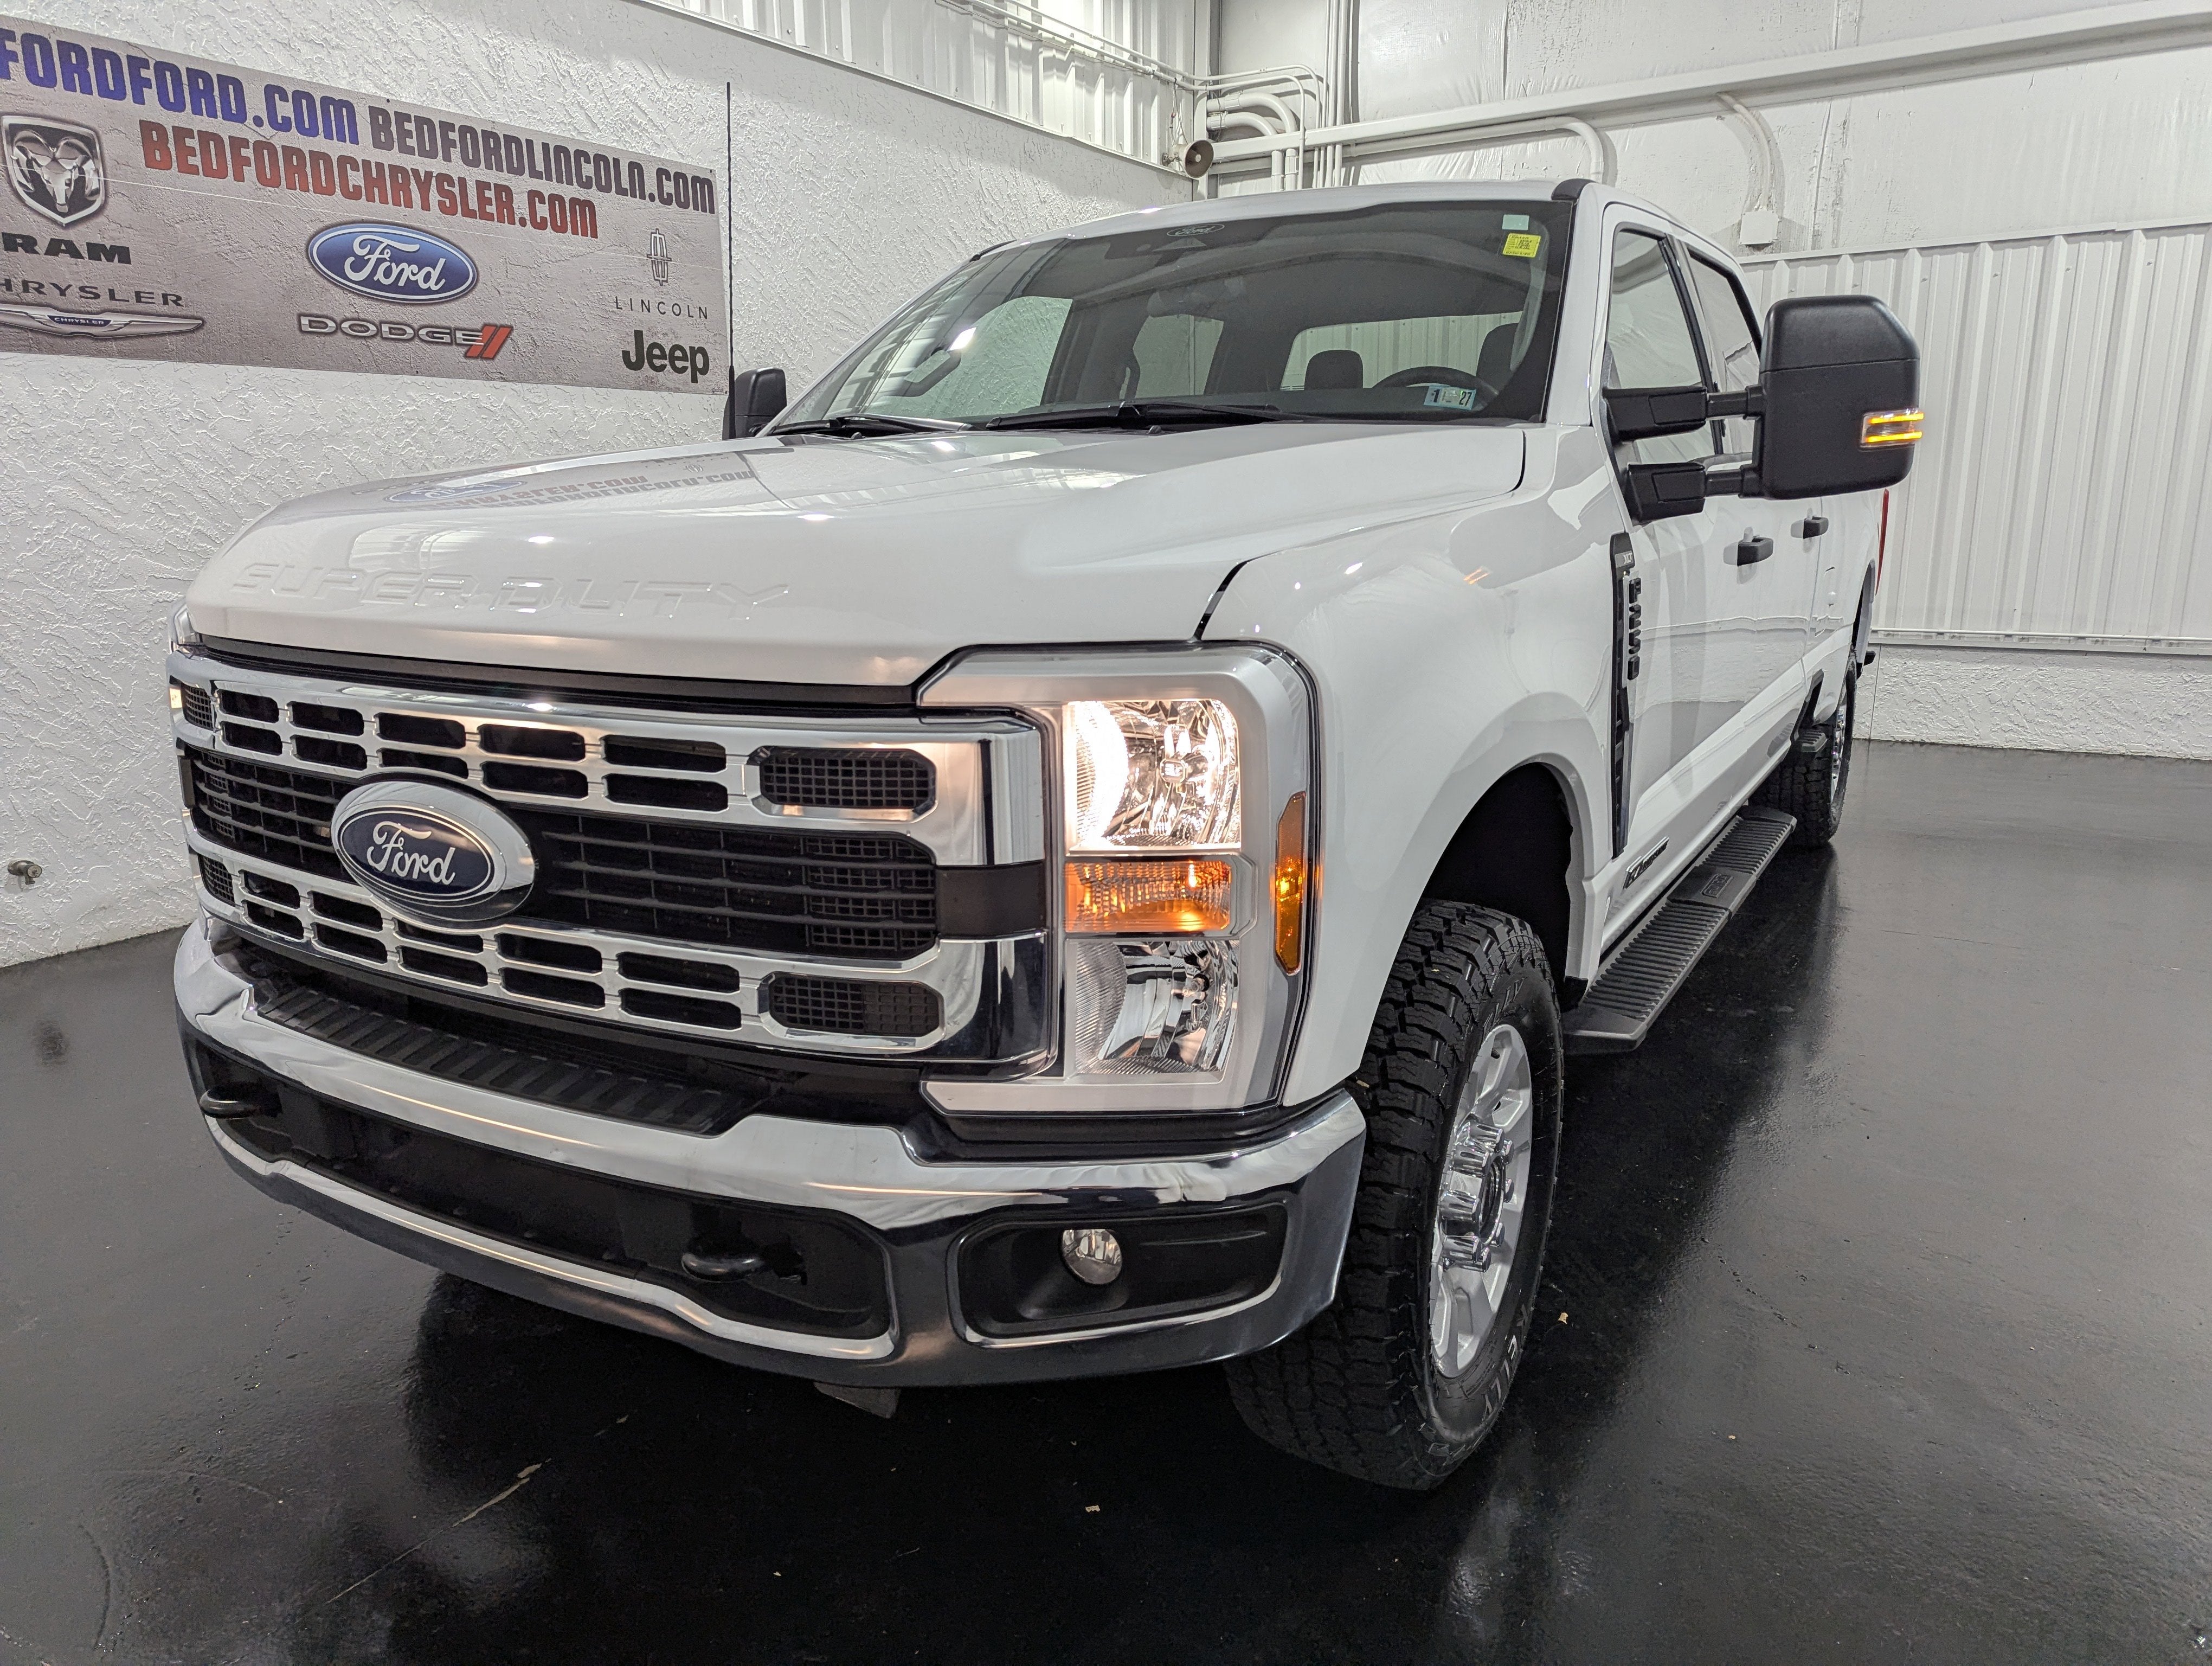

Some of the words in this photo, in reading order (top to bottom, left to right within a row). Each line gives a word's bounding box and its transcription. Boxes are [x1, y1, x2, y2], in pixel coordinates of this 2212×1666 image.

[139, 119, 598, 239] BEDFORDCHRYSLER.COM
[368, 105, 715, 214] BEDFORDLINCOLN.COM
[2, 232, 132, 265] RAM
[344, 234, 446, 291] Ford
[54, 317, 104, 325] CHRYSLER
[300, 316, 484, 345] DODGE
[615, 296, 708, 319] LINCOLN
[622, 330, 710, 383] Jeep
[1459, 390, 1472, 406] 27
[231, 562, 480, 609] SUPER
[489, 576, 789, 620] DUTY
[366, 821, 456, 885] Ford
